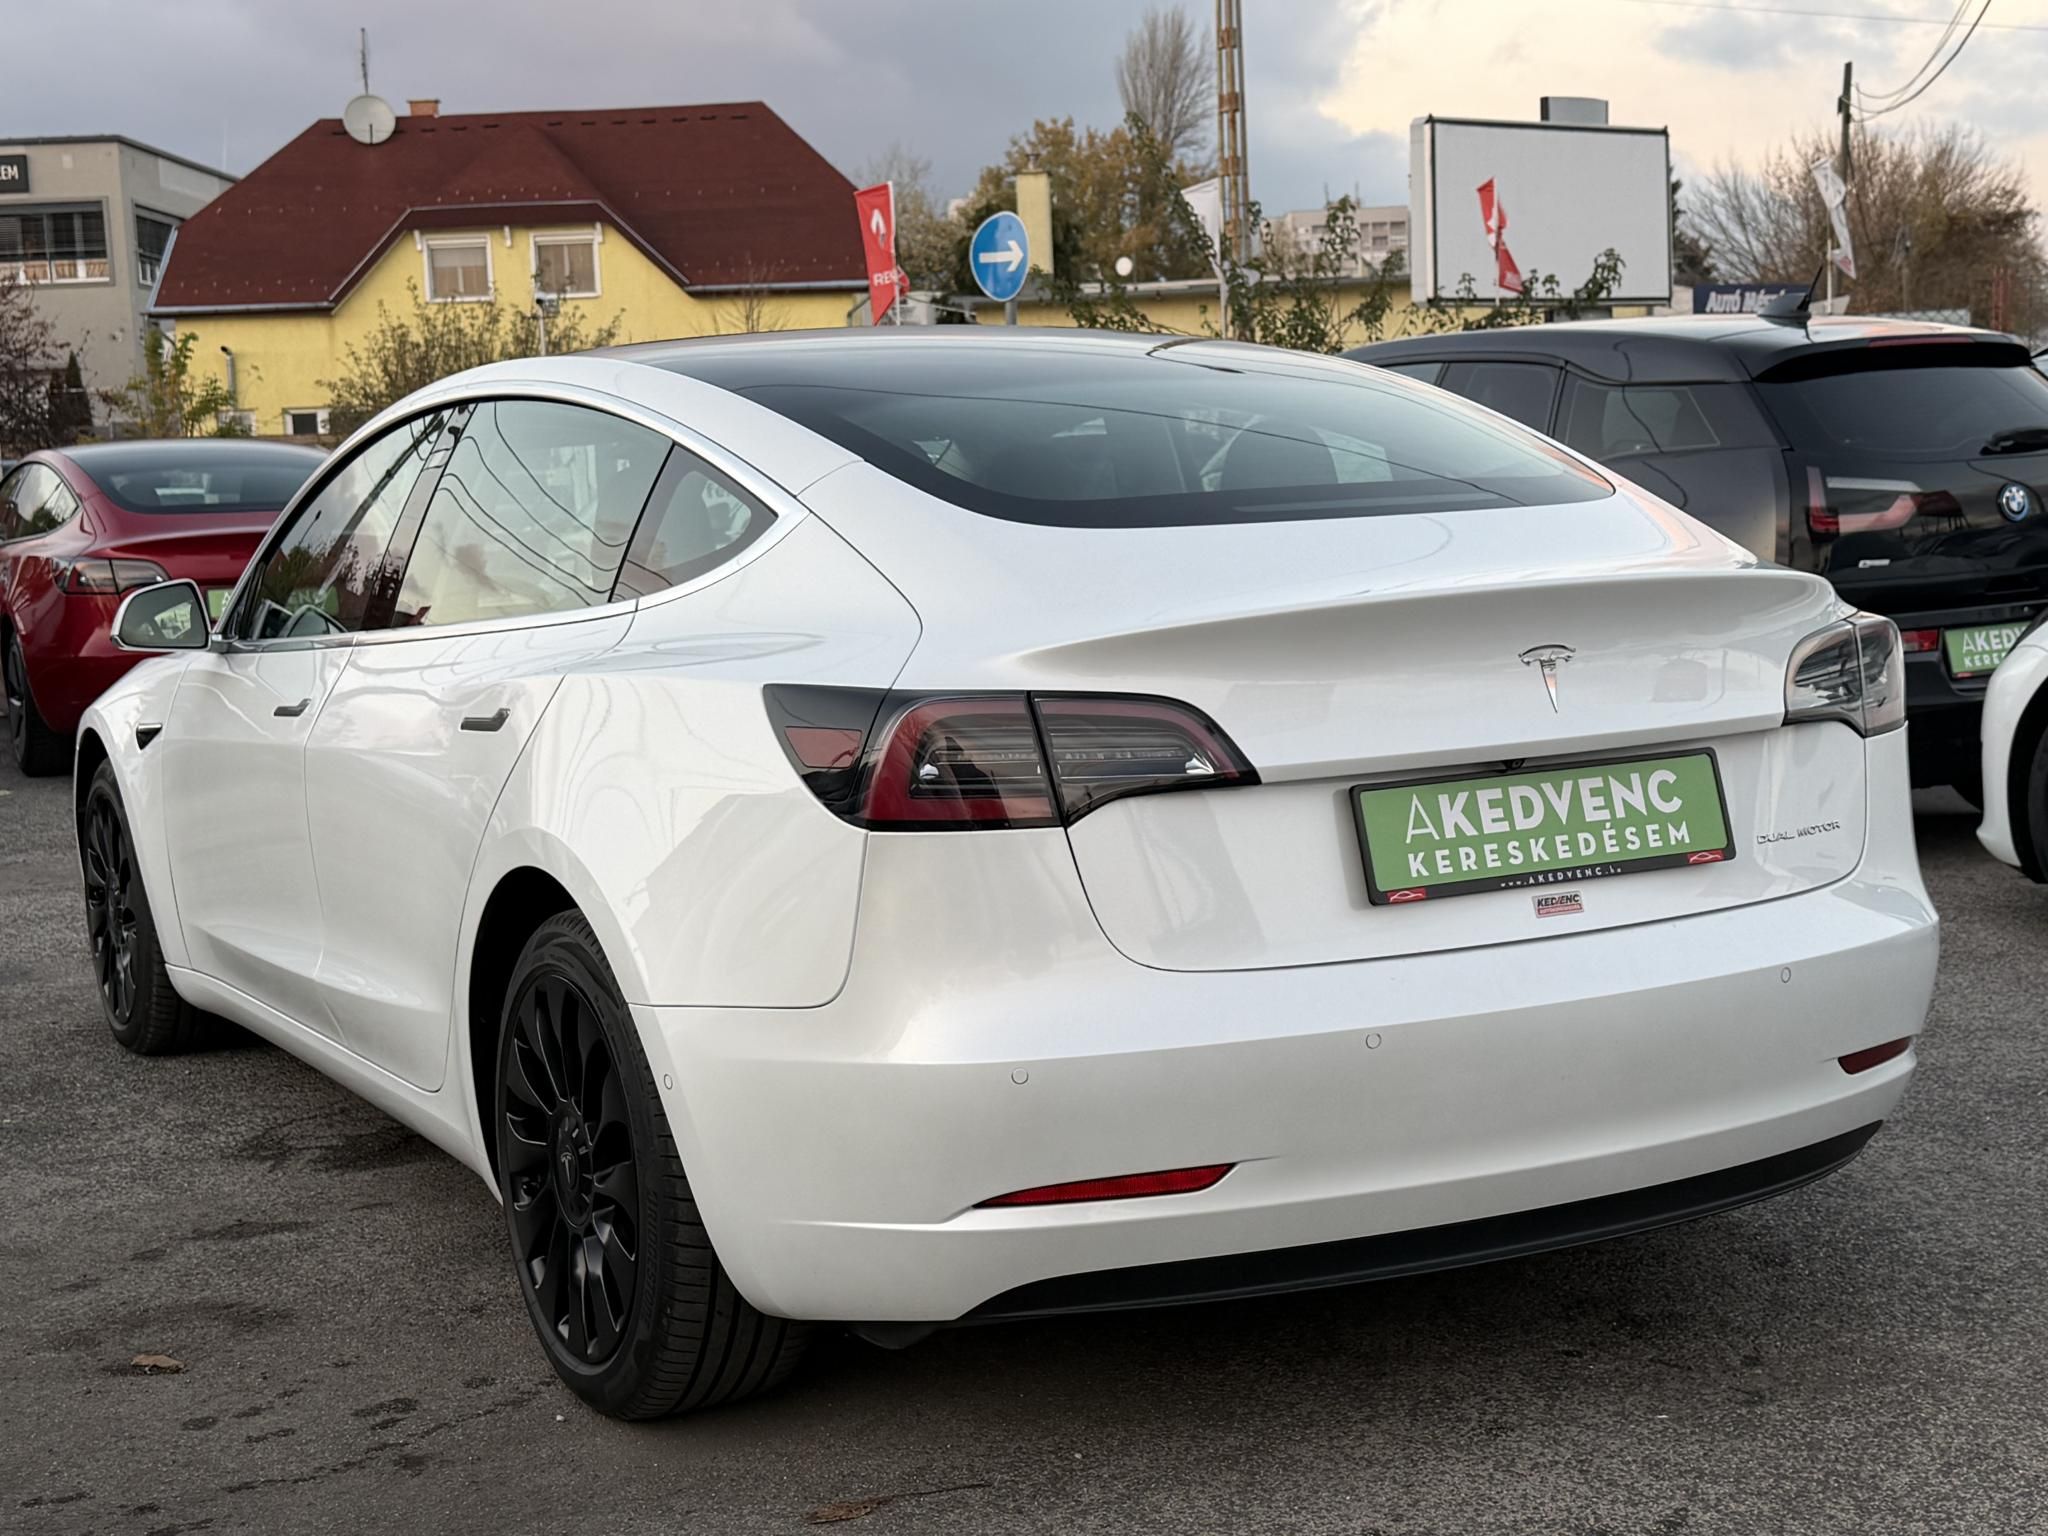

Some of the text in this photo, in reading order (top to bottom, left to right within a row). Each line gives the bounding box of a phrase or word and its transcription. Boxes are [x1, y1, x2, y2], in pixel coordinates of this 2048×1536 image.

[0, 164, 19, 180] EM
[1406, 769, 1683, 844] AKEDVENC
[1407, 820, 1691, 878] KERESKEDÉSEM
[1756, 820, 1841, 845] DUAL MOTOR
